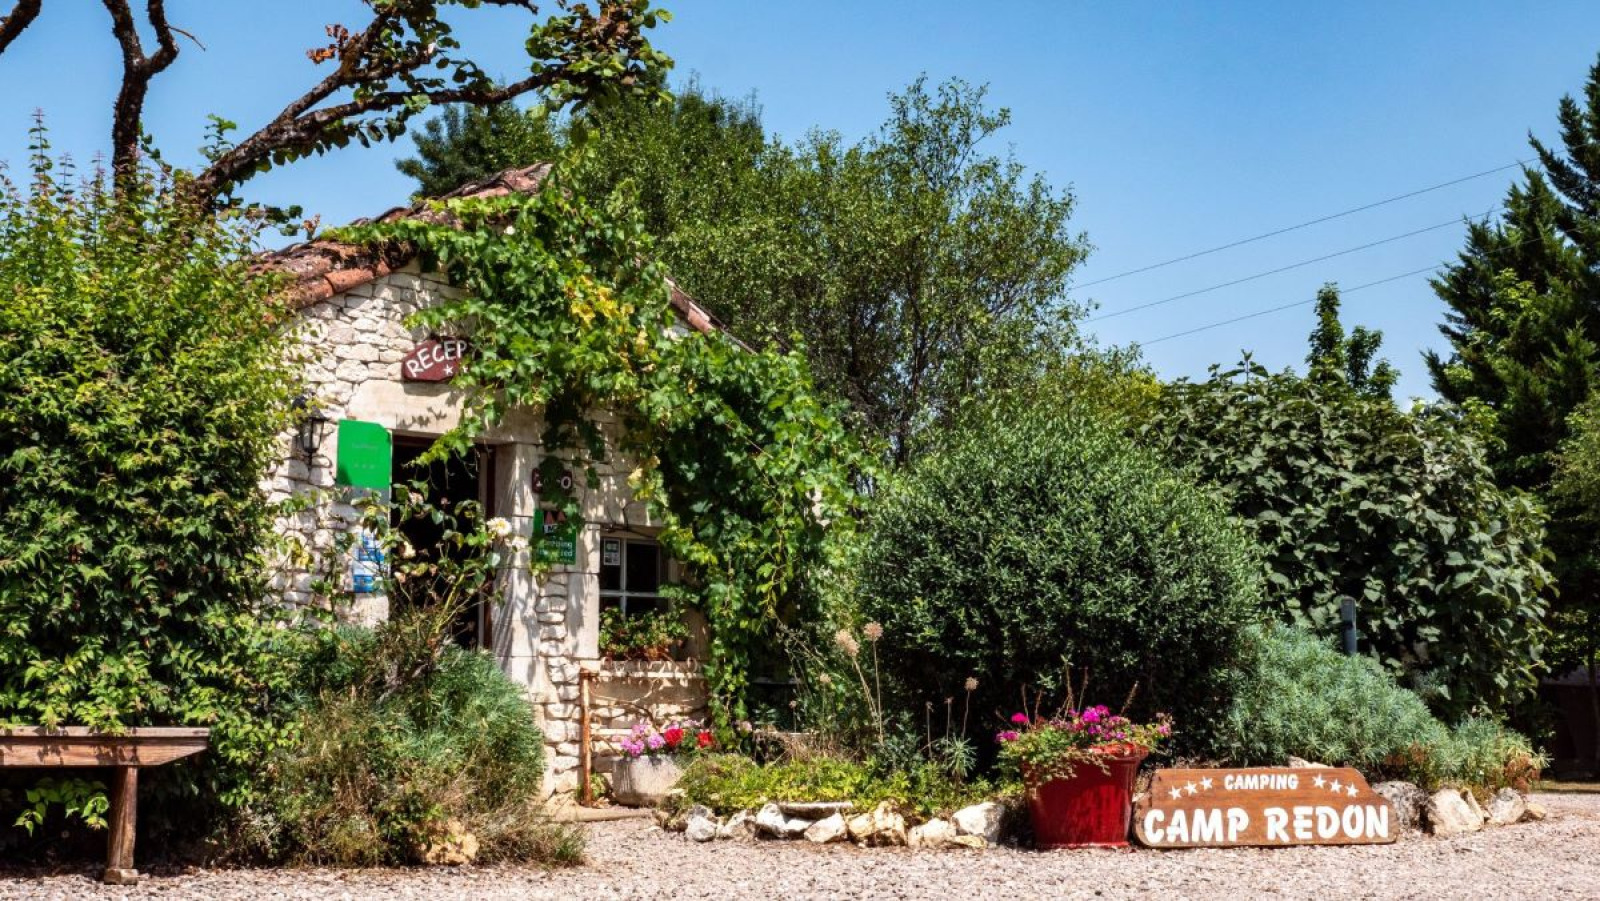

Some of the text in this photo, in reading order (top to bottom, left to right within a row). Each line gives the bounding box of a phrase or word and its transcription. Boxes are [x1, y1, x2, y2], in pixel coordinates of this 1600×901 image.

[1223, 774, 1299, 791] CAMPING
[1143, 804, 1390, 844] CAMP REDON
